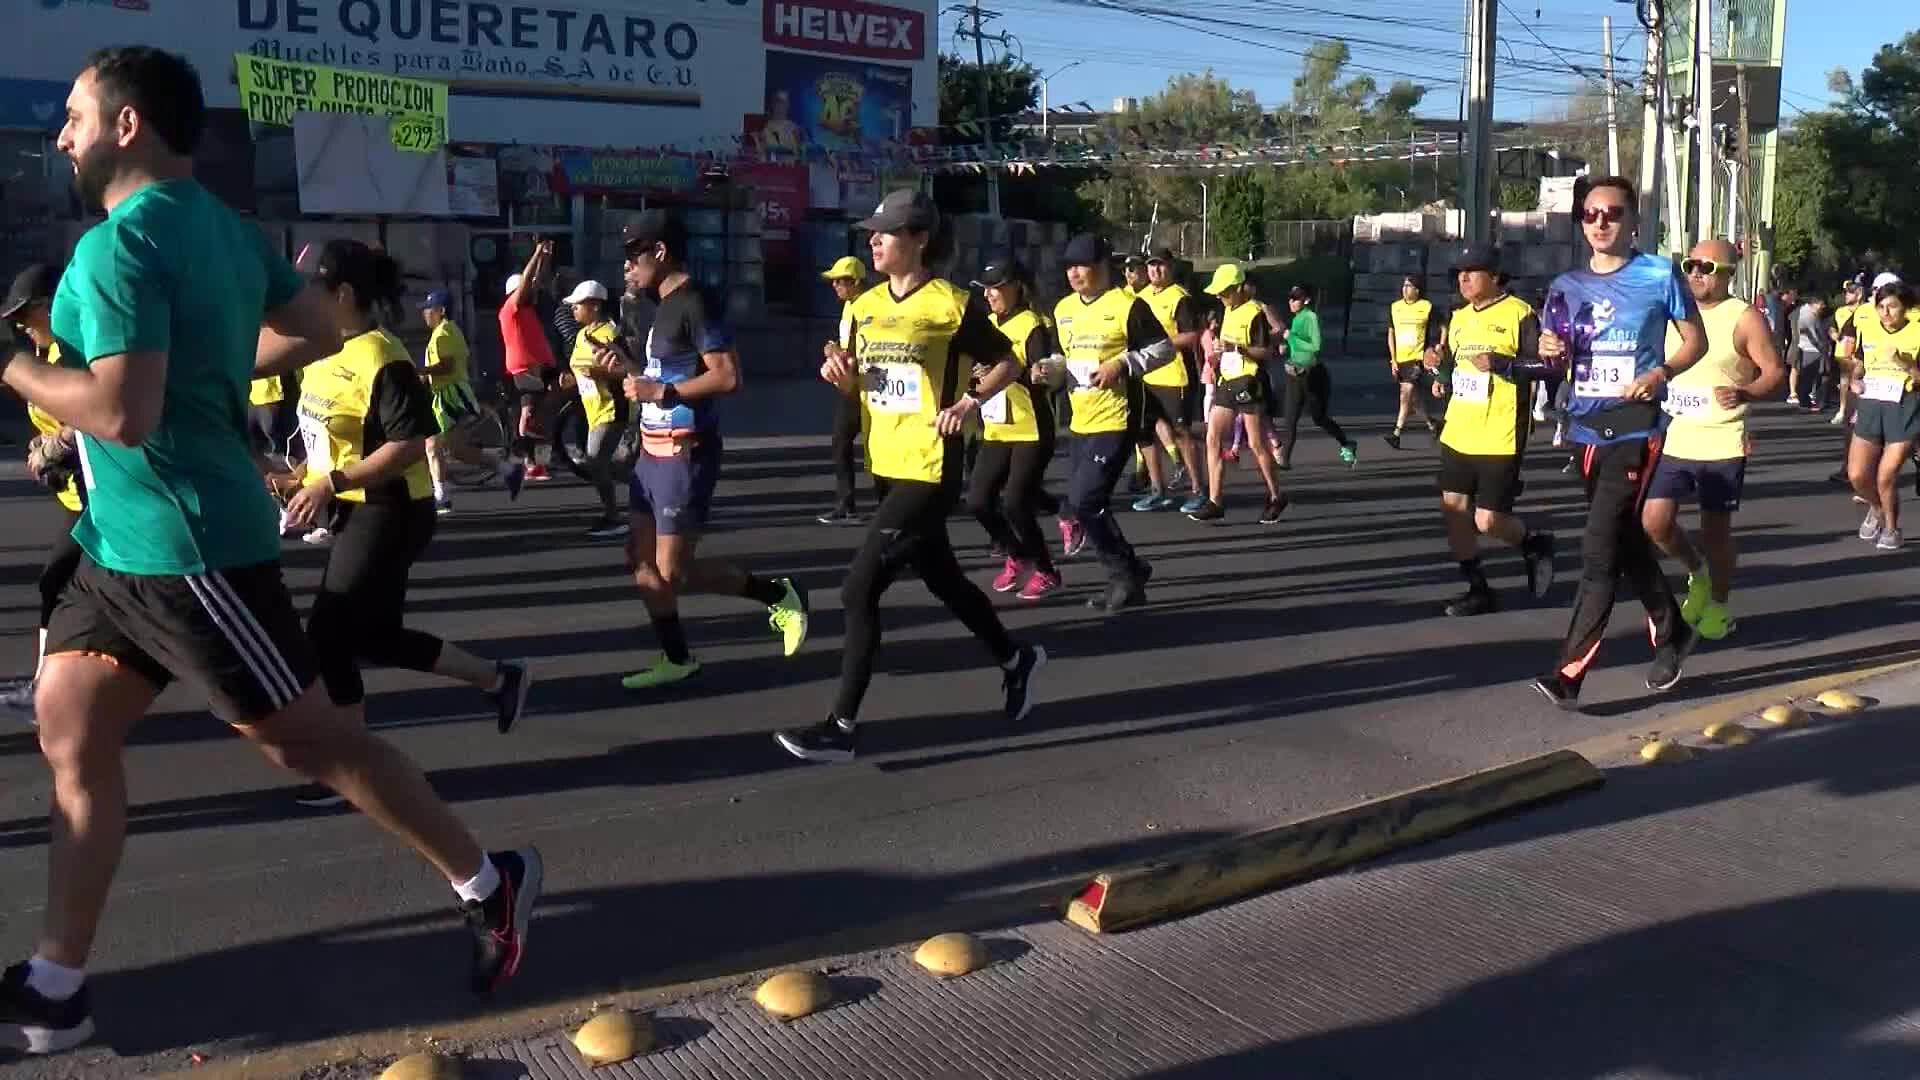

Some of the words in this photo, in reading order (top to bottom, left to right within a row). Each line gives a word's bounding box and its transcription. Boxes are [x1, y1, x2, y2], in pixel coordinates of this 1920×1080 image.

[238, 0, 318, 34] DE
[339, 0, 699, 61] QUERETARO
[775, 3, 913, 50] HELVEX
[250, 60, 317, 97] SUPER
[333, 72, 433, 112] PROMOCION
[393, 53, 450, 74] para
